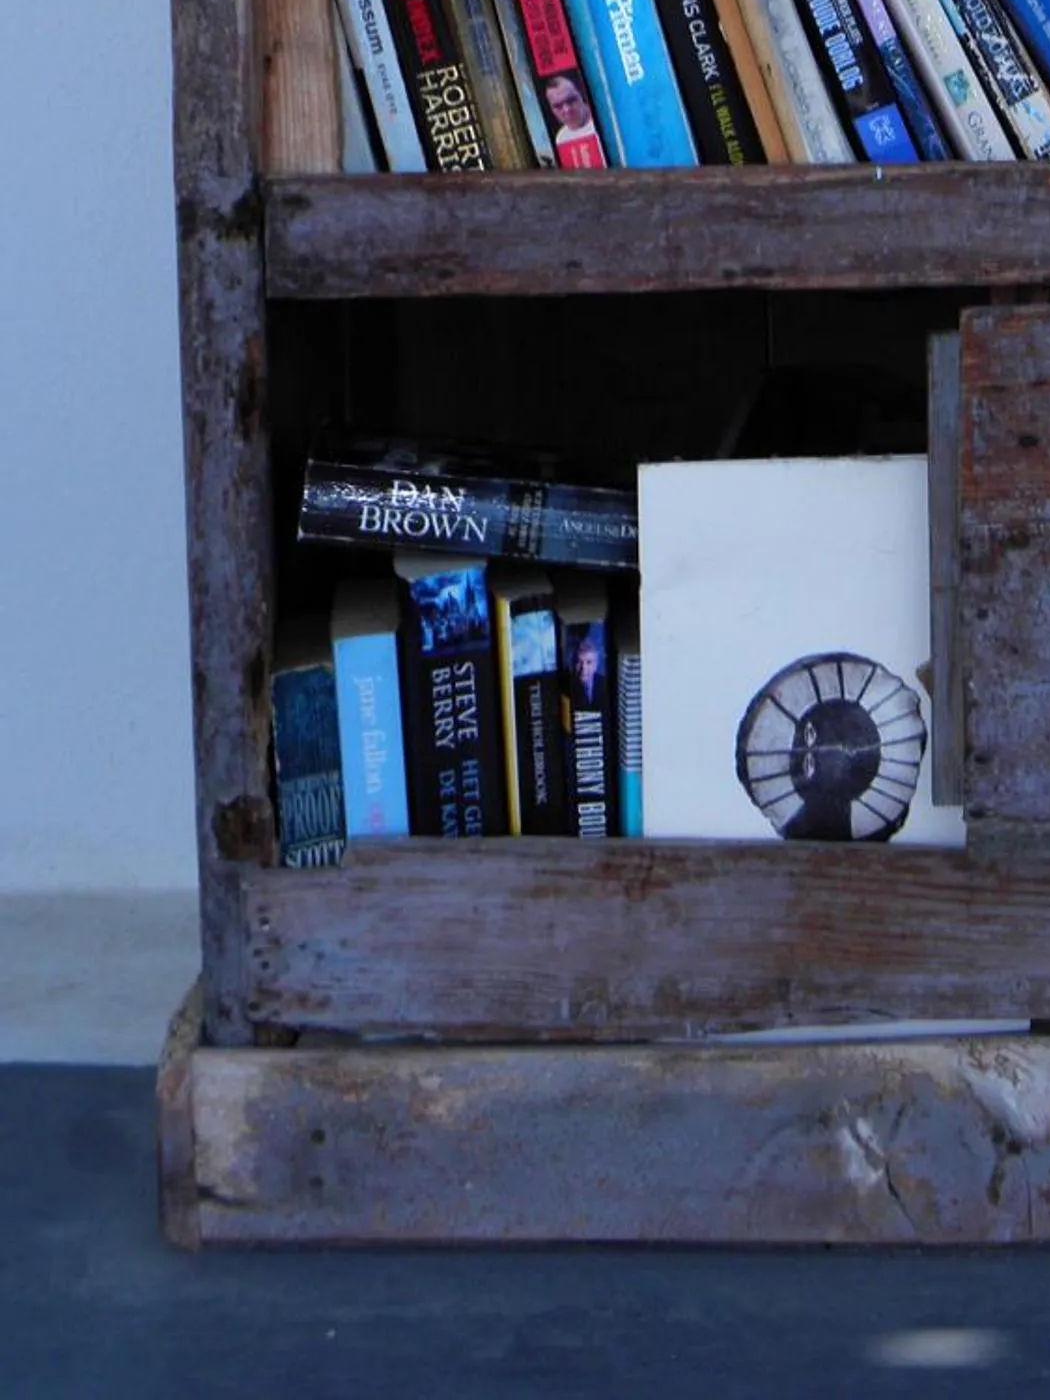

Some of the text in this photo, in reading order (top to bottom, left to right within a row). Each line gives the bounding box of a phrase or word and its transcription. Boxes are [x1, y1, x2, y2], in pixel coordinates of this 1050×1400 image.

[689, 18, 721, 82] CLARK
[824, 31, 864, 91] OORLOG
[436, 65, 484, 173] ROBERT
[358, 504, 488, 543] BROWN
[389, 479, 467, 514] DAN
[353, 675, 384, 726] jane
[432, 667, 455, 749] BERRY
[454, 661, 478, 742] STEVE
[361, 728, 388, 795] fallon
[462, 758, 480, 801] HET
[574, 710, 606, 795] ANTHONY
[281, 781, 343, 841] PROOF
[439, 768, 456, 798] DE
